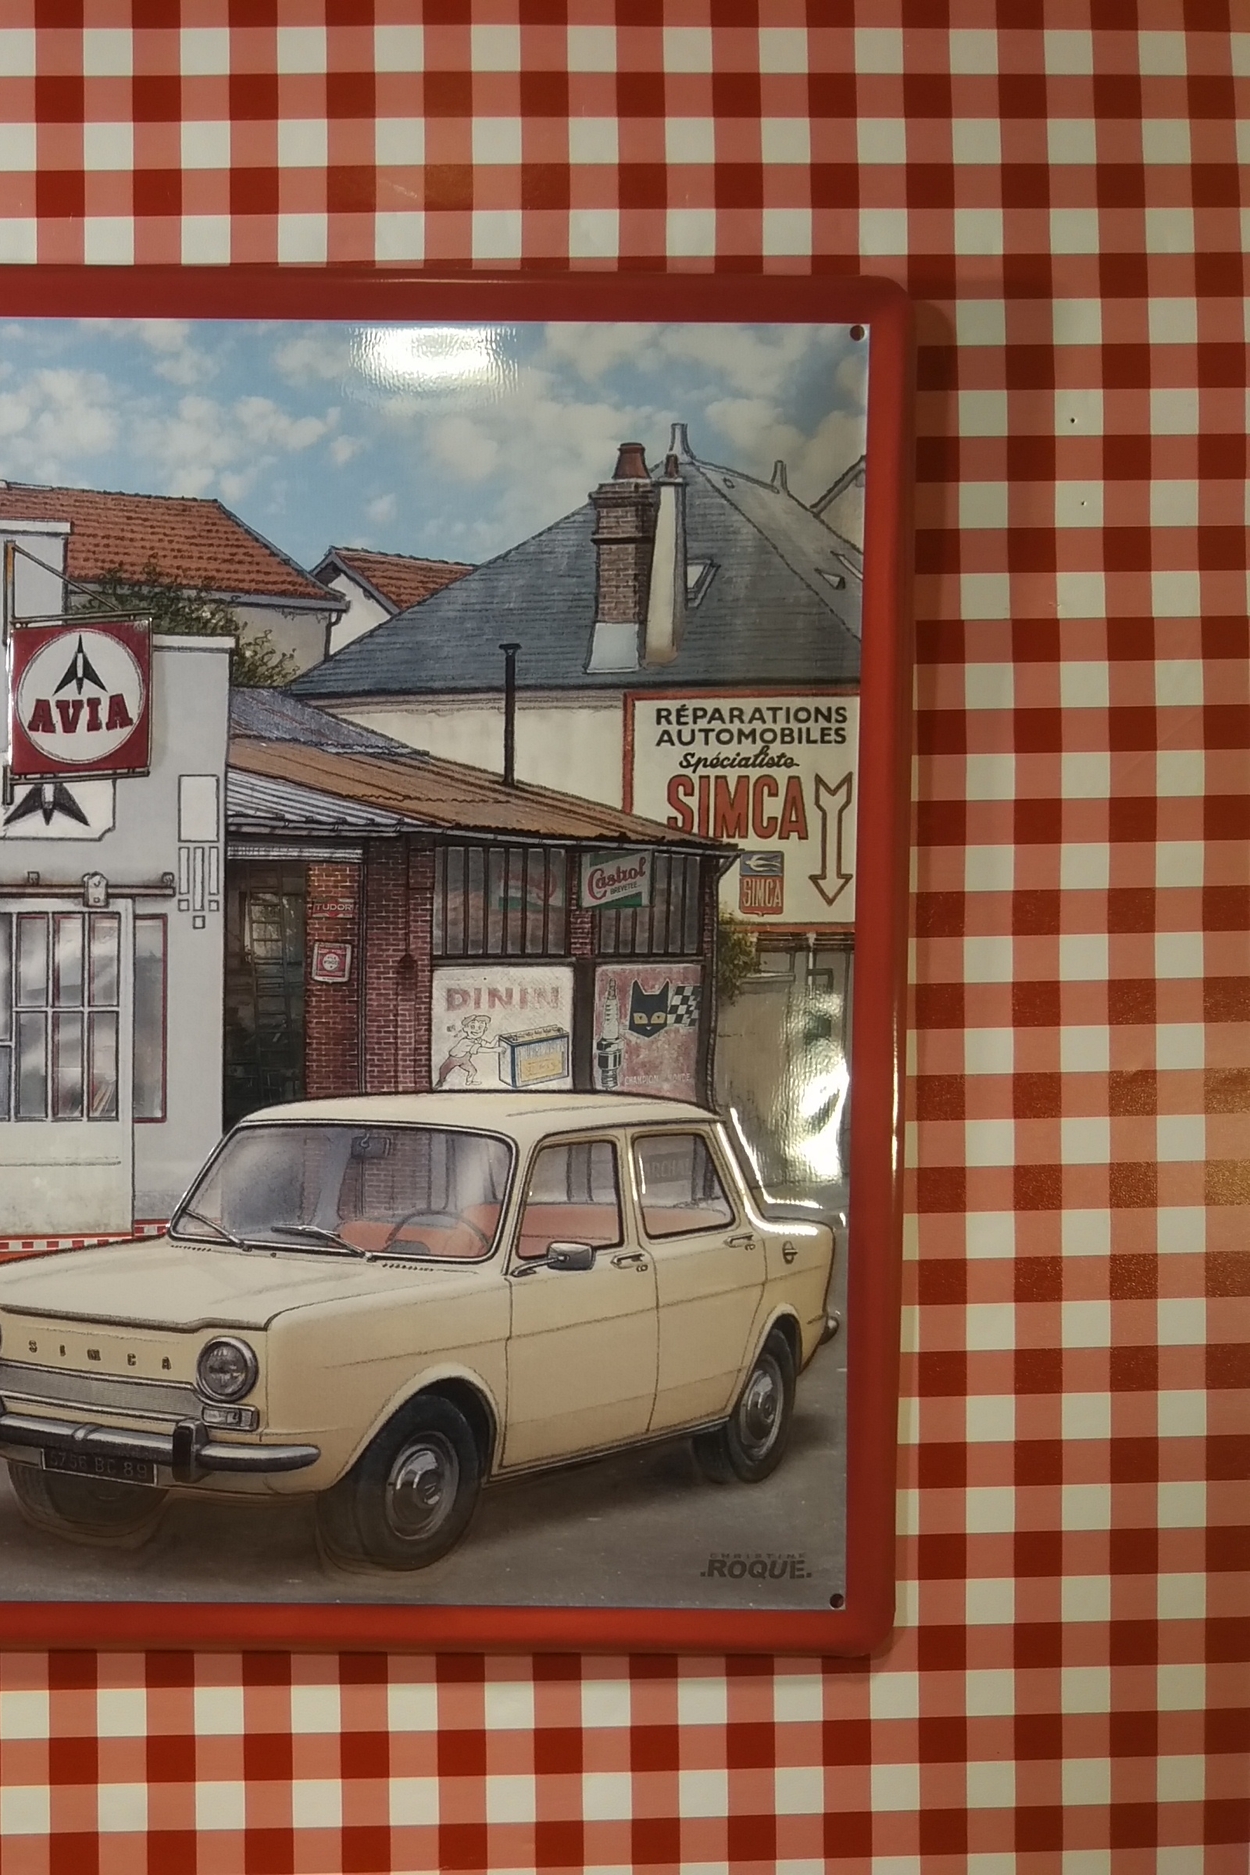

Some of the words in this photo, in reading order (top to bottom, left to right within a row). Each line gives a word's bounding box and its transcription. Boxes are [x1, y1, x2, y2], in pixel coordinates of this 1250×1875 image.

[28, 694, 133, 735] AVIA
[655, 705, 848, 726] RÉPARATIONS
[655, 727, 847, 747] AUTOMOBILES
[667, 774, 808, 840] SIMCA
[588, 856, 646, 900] Castrol
[743, 878, 782, 907] SIMCA
[315, 903, 351, 911] TUDOR
[29, 1340, 171, 1371] SIMCA
